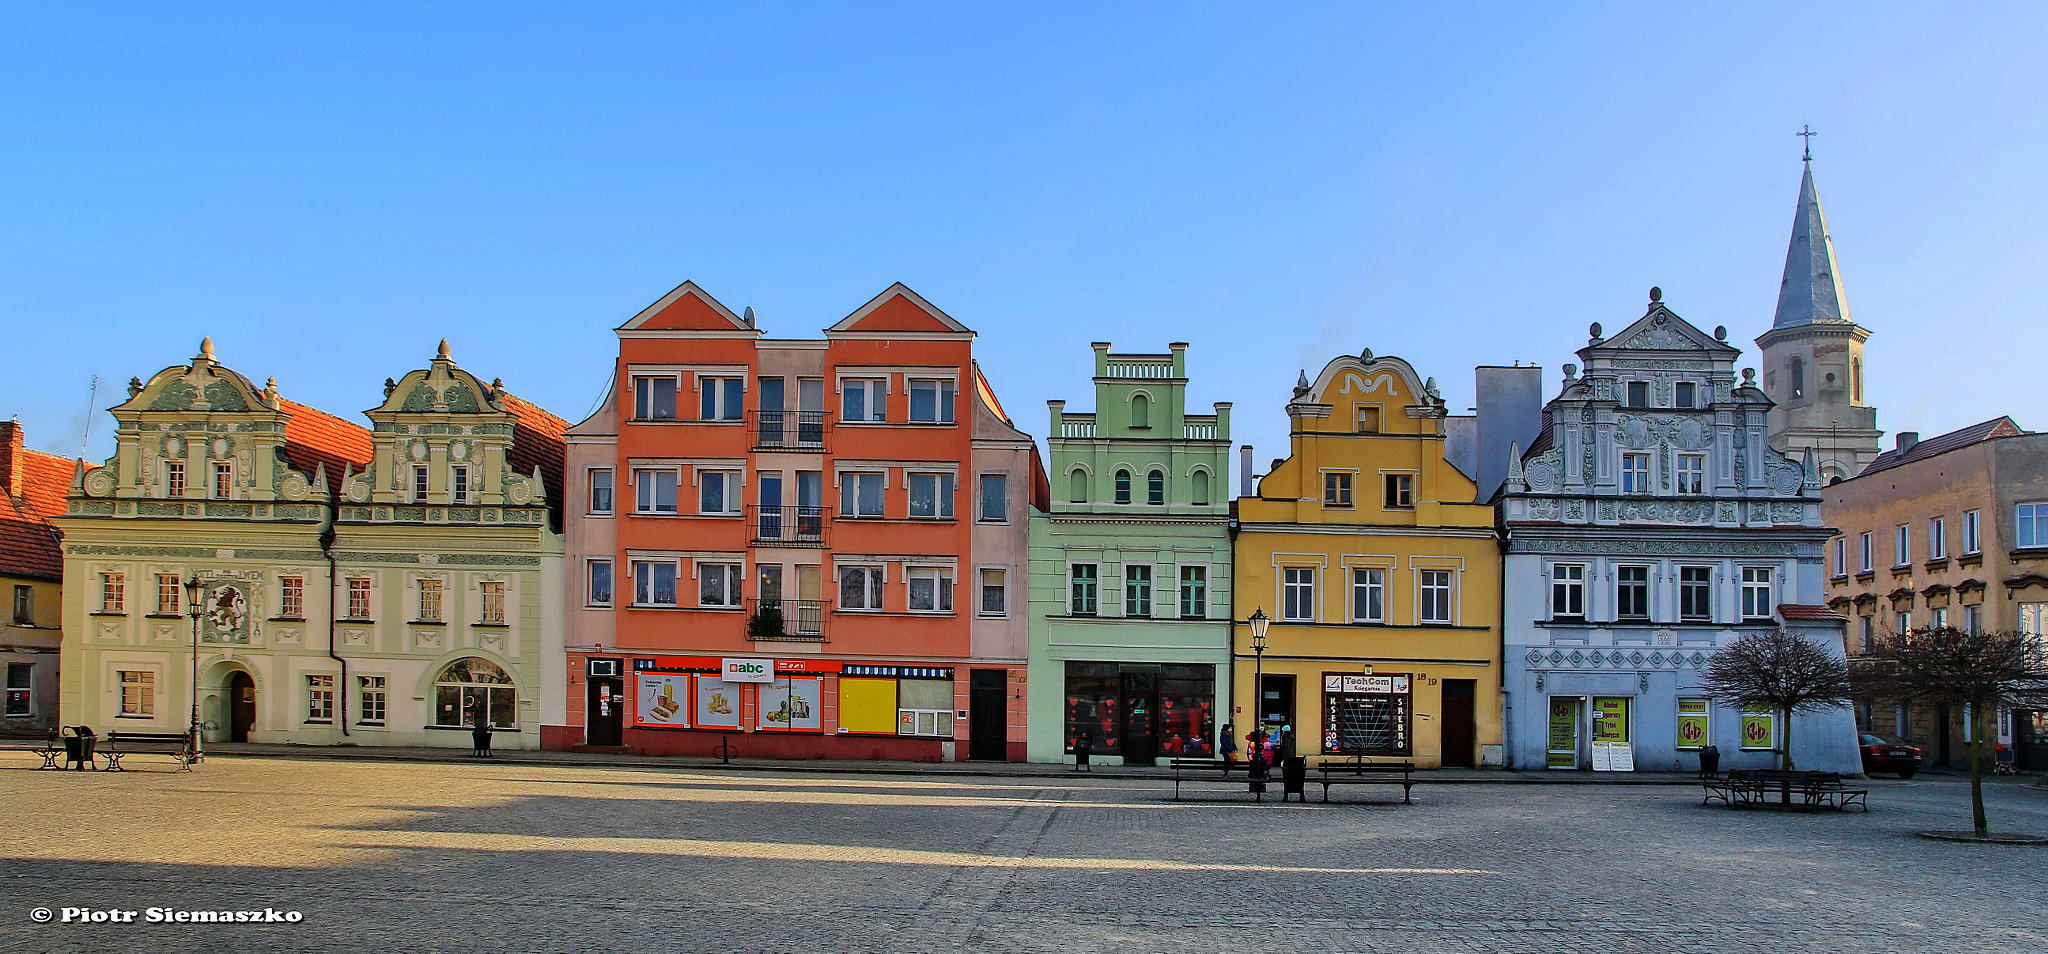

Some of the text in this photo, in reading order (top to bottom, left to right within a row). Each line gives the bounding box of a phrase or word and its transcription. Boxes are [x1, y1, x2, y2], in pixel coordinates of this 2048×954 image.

[738, 663, 764, 673] abc
[1416, 673, 1427, 681] 18
[1345, 677, 1390, 686] TechCom
[1427, 678, 1438, 686] 19
